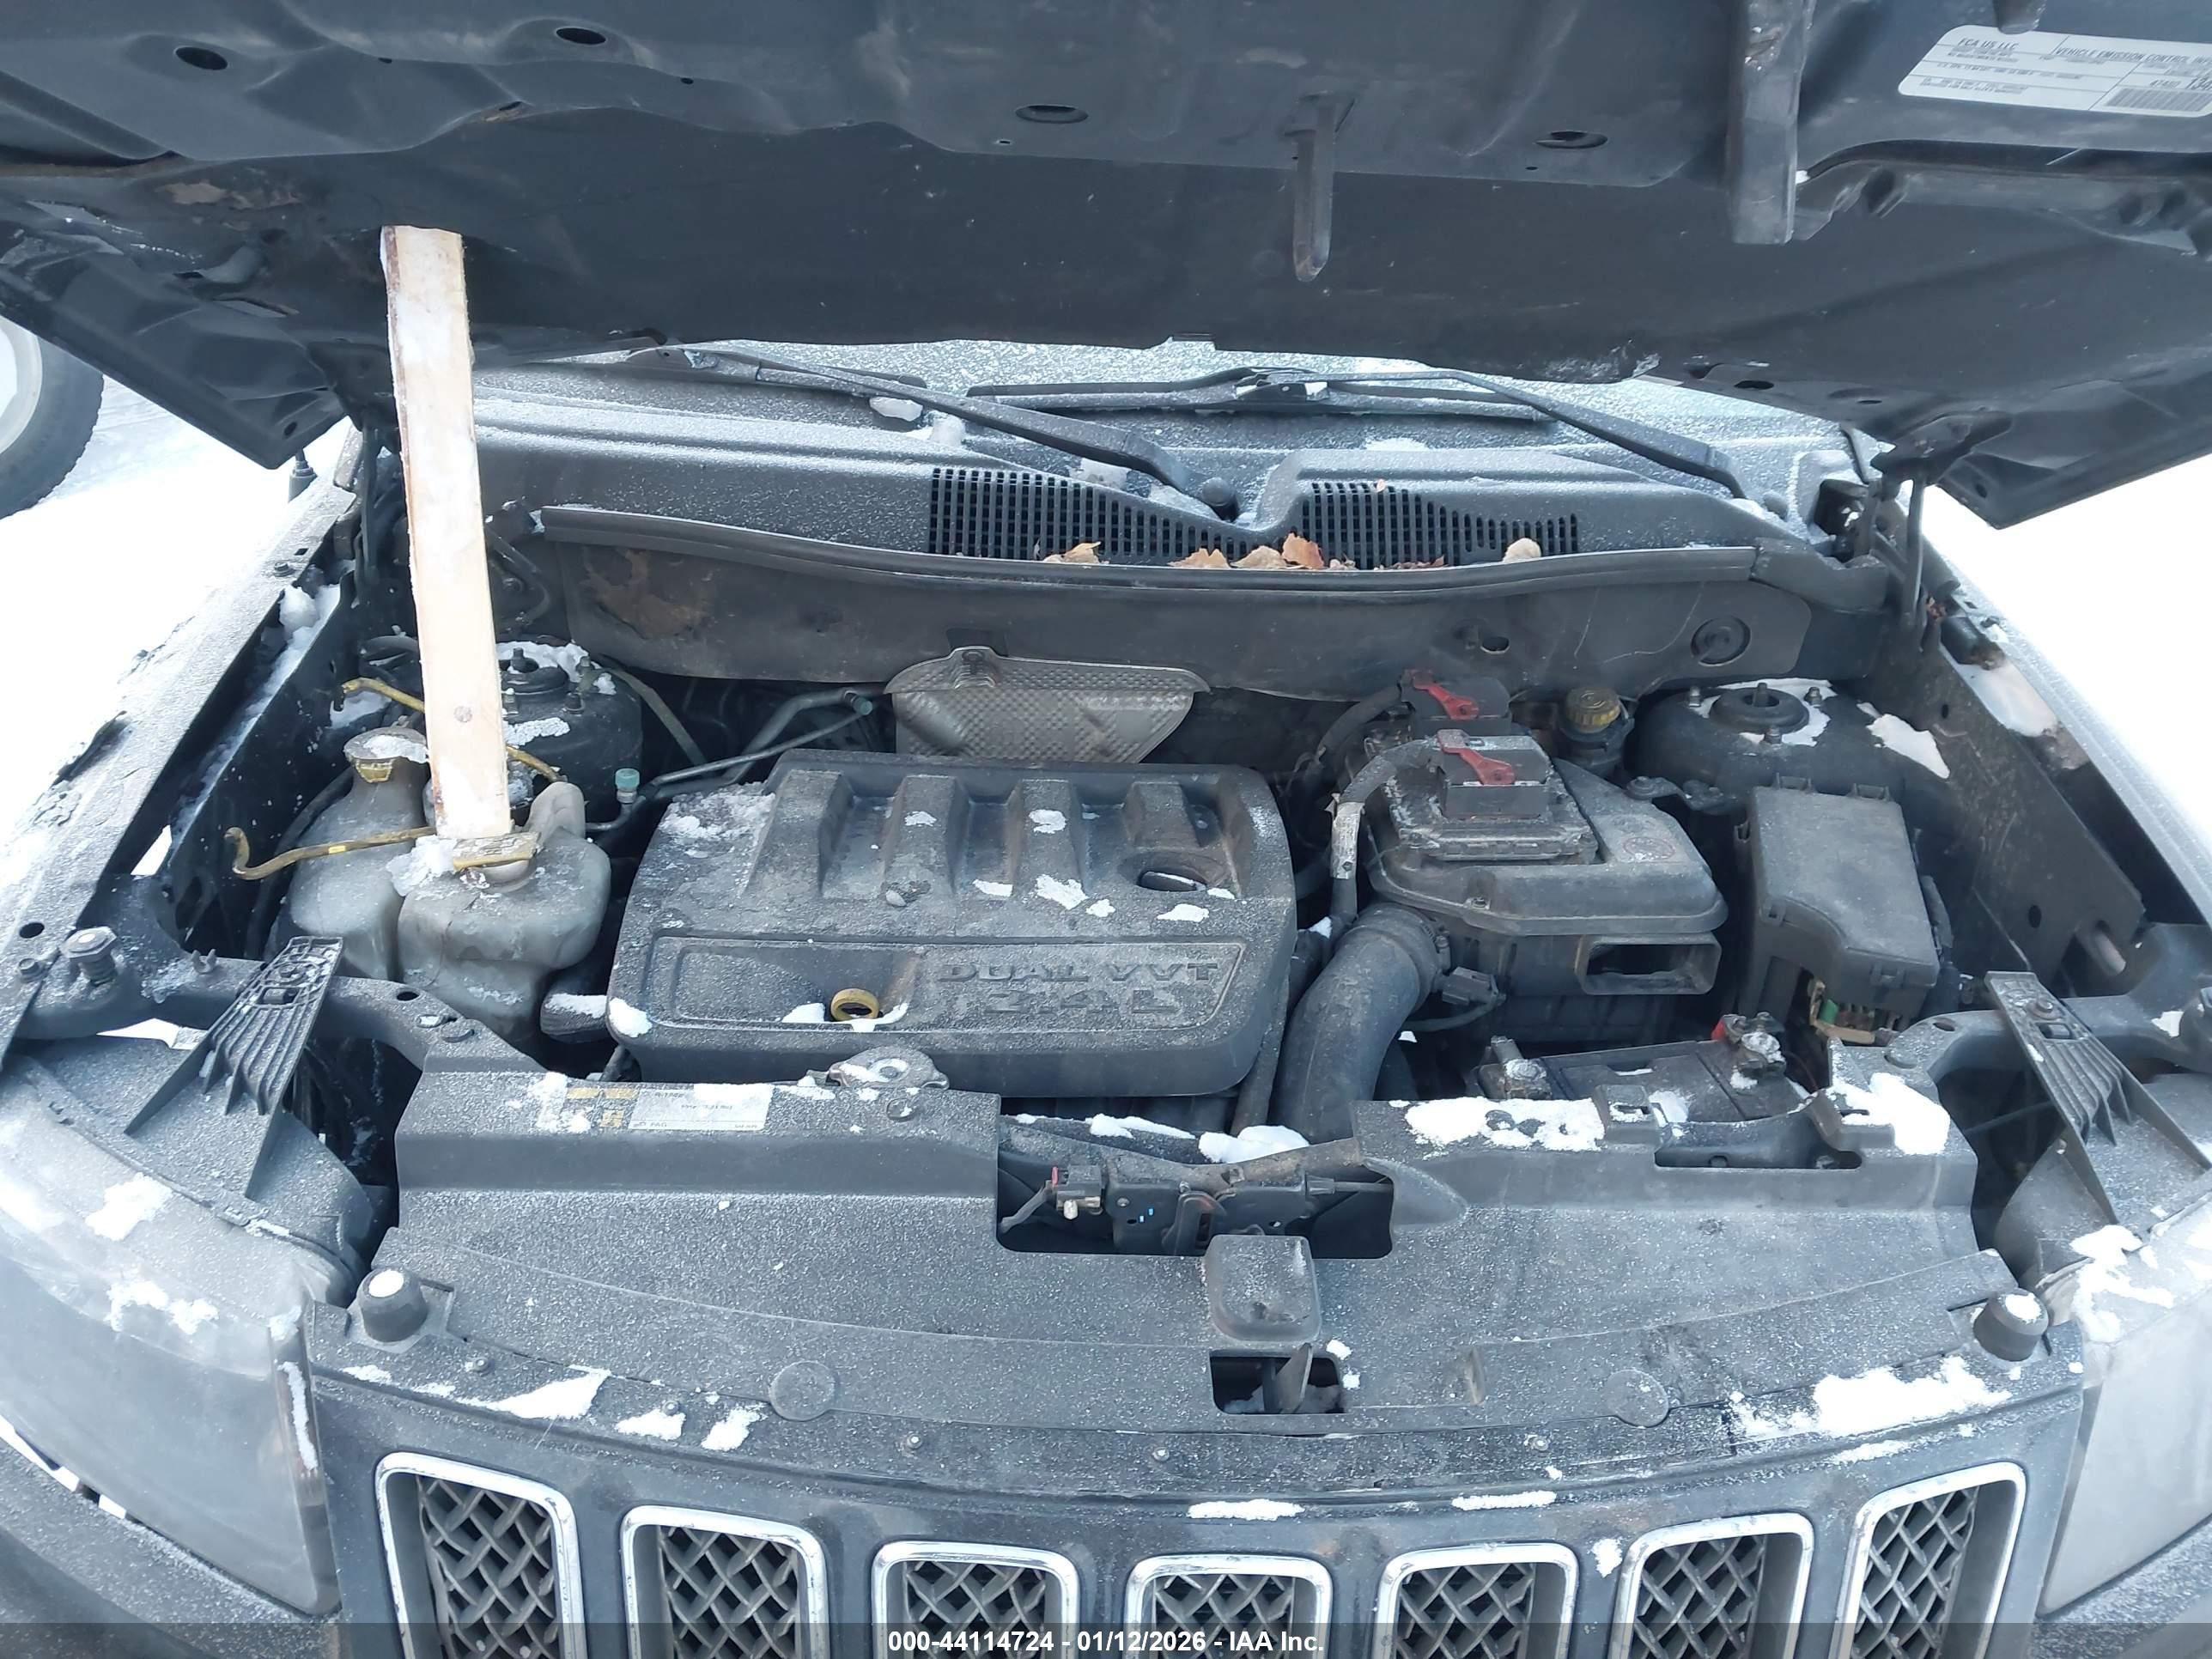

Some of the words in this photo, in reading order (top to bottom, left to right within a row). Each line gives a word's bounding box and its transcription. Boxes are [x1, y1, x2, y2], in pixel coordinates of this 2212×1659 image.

[1958, 38, 1979, 47] FCA
[1981, 40, 1996, 49] US
[1996, 41, 2020, 51] LLC
[2056, 47, 2097, 58] VEHICLE
[2096, 50, 2146, 62] EMISSION
[2144, 53, 2191, 63] CONTROL
[939, 962, 1090, 982] DUAL
[1103, 961, 1218, 982] VVT
